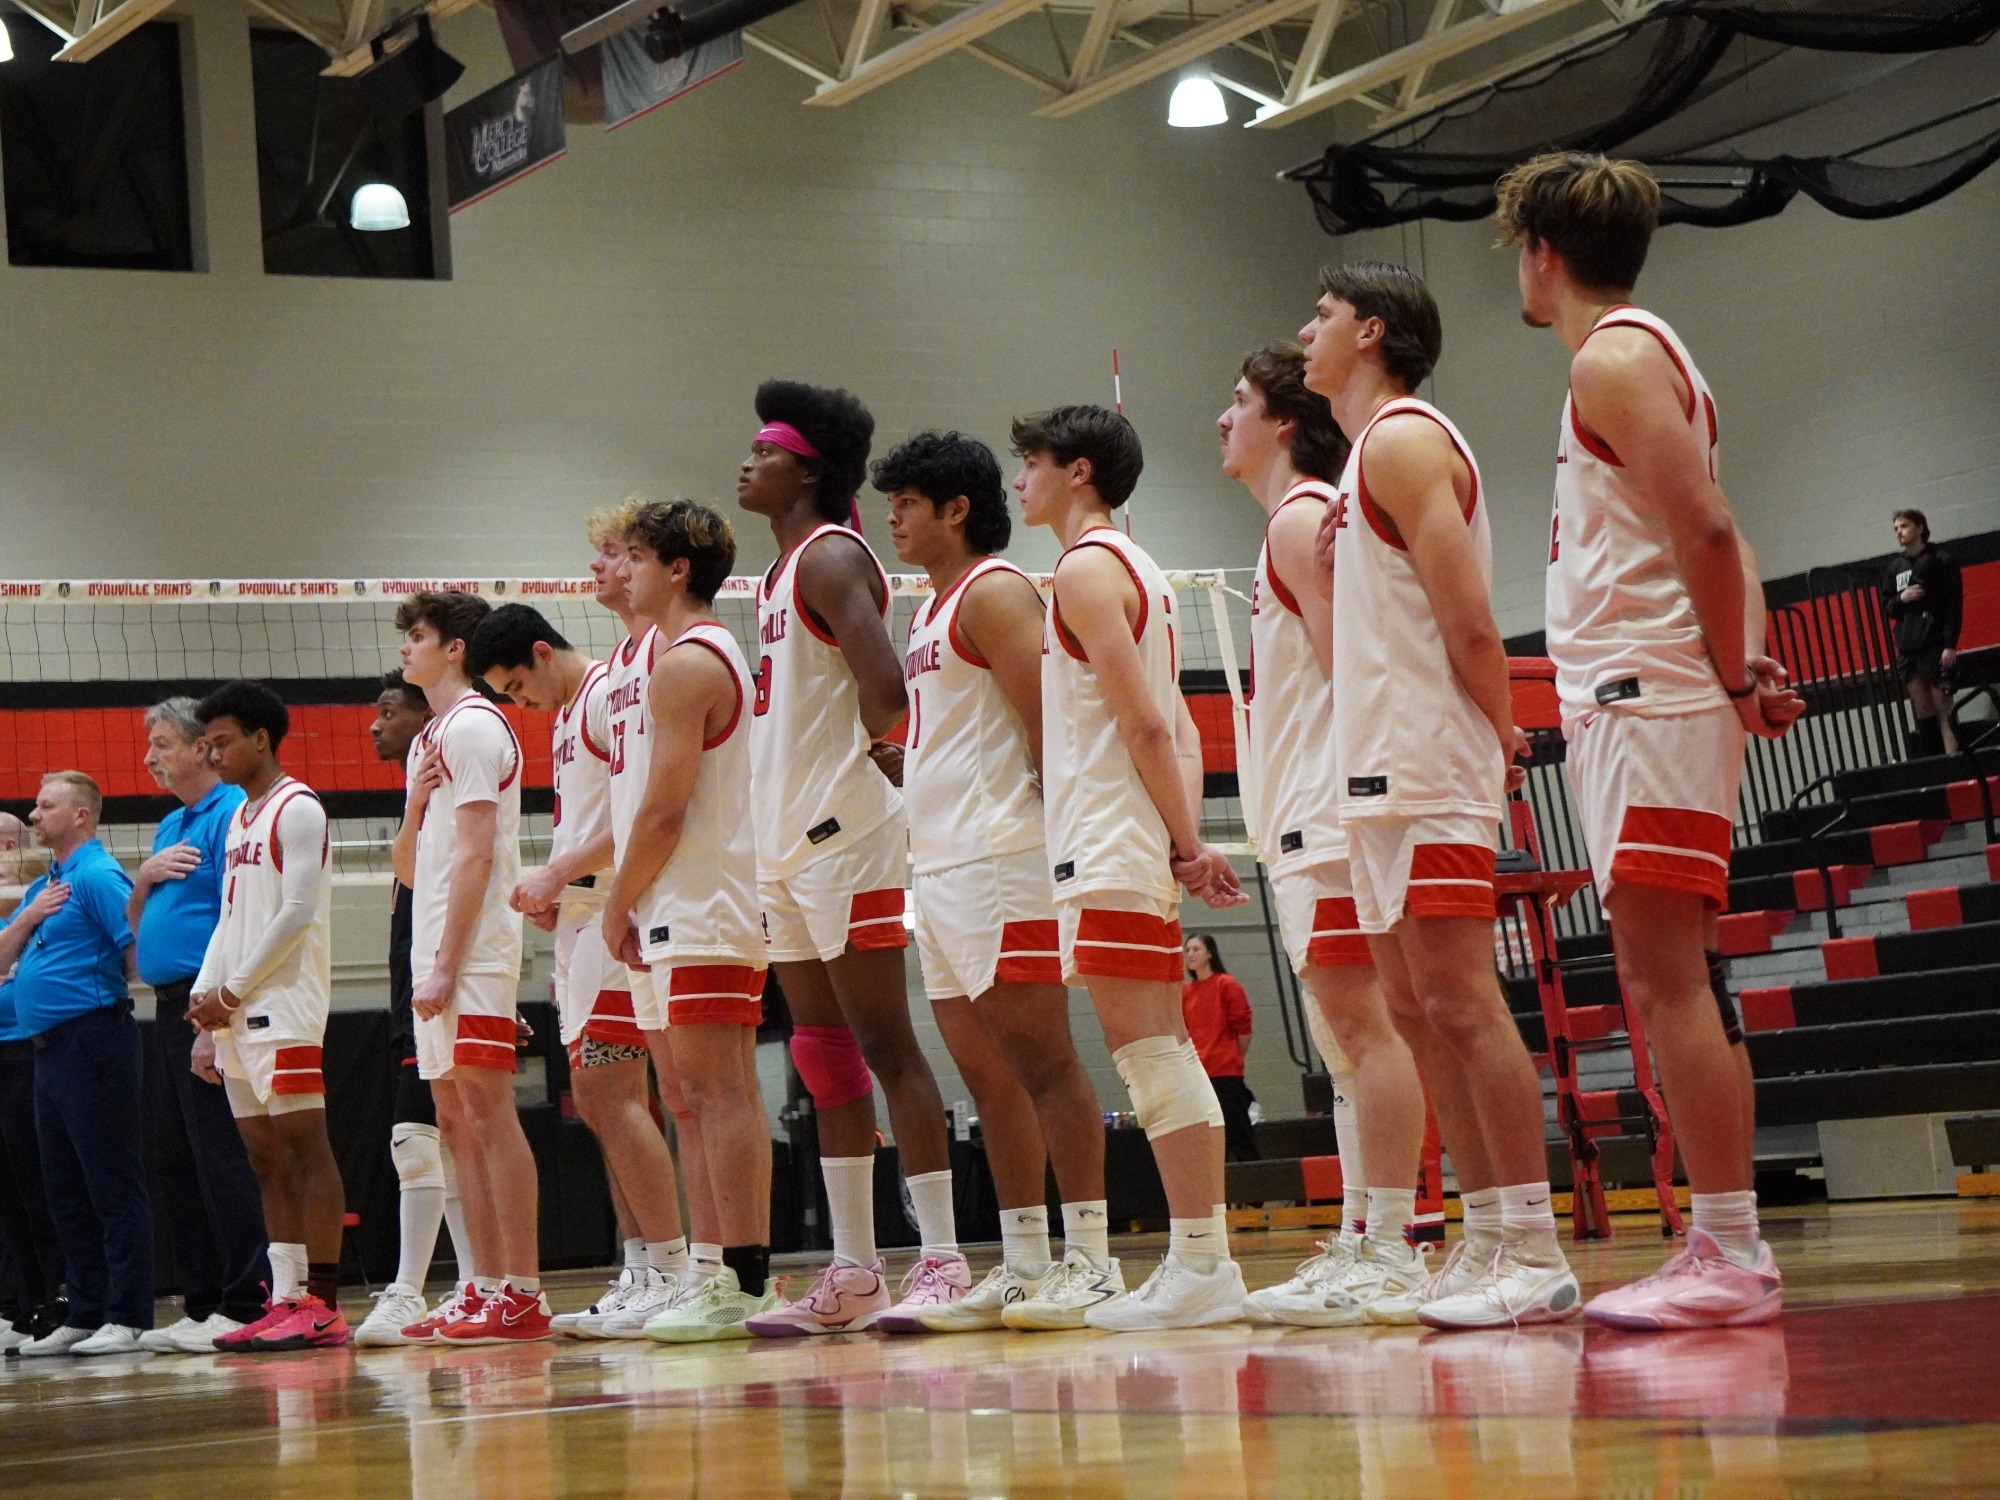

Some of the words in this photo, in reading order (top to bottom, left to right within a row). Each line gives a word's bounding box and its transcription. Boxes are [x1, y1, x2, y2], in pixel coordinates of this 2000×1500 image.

[0, 583, 41, 596] SAINTS
[153, 582, 192, 596] SAINTS
[300, 582, 338, 595] SAINTS
[580, 582, 599, 594] SAI
[720, 578, 749, 591] AINTS
